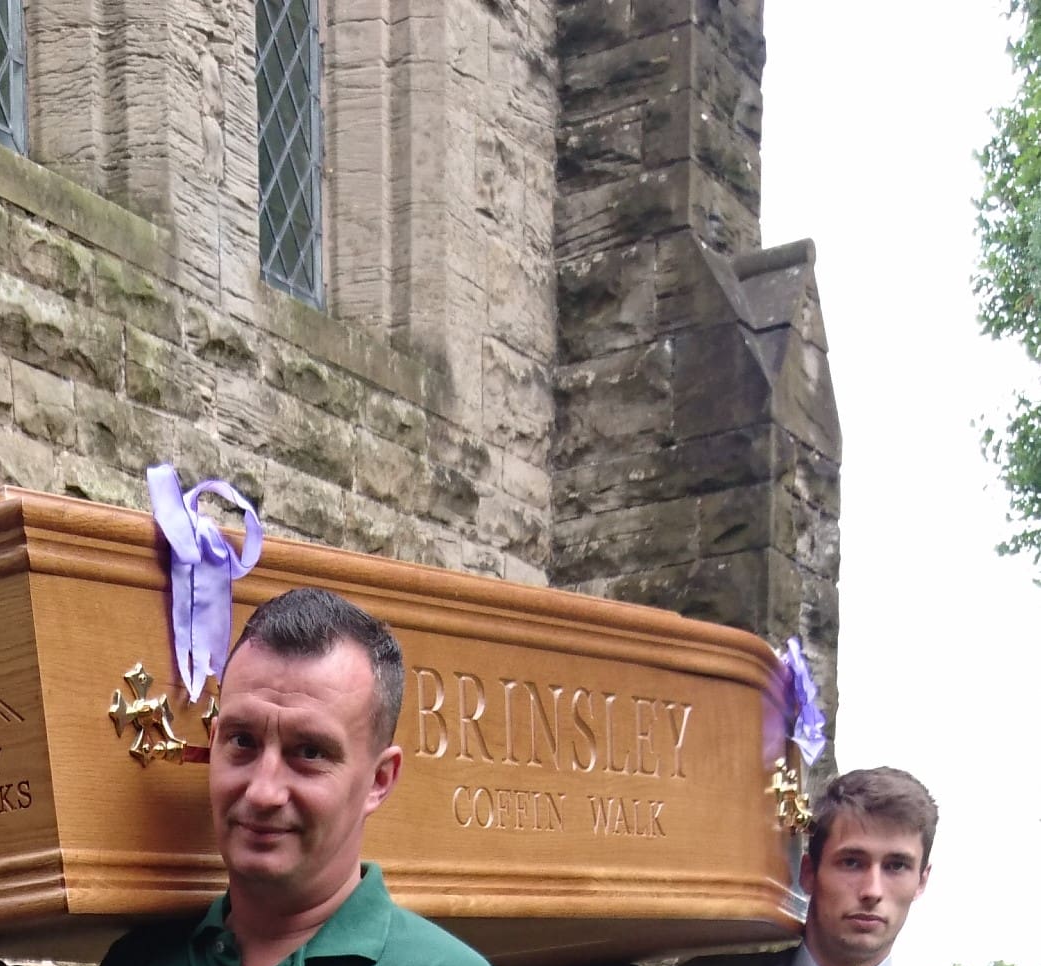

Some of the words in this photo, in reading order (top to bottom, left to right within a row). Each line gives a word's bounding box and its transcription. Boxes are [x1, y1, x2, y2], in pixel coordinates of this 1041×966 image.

[412, 666, 693, 780] BRINSLEY
[452, 785, 566, 832] COFFIN
[587, 795, 667, 838] WALK
